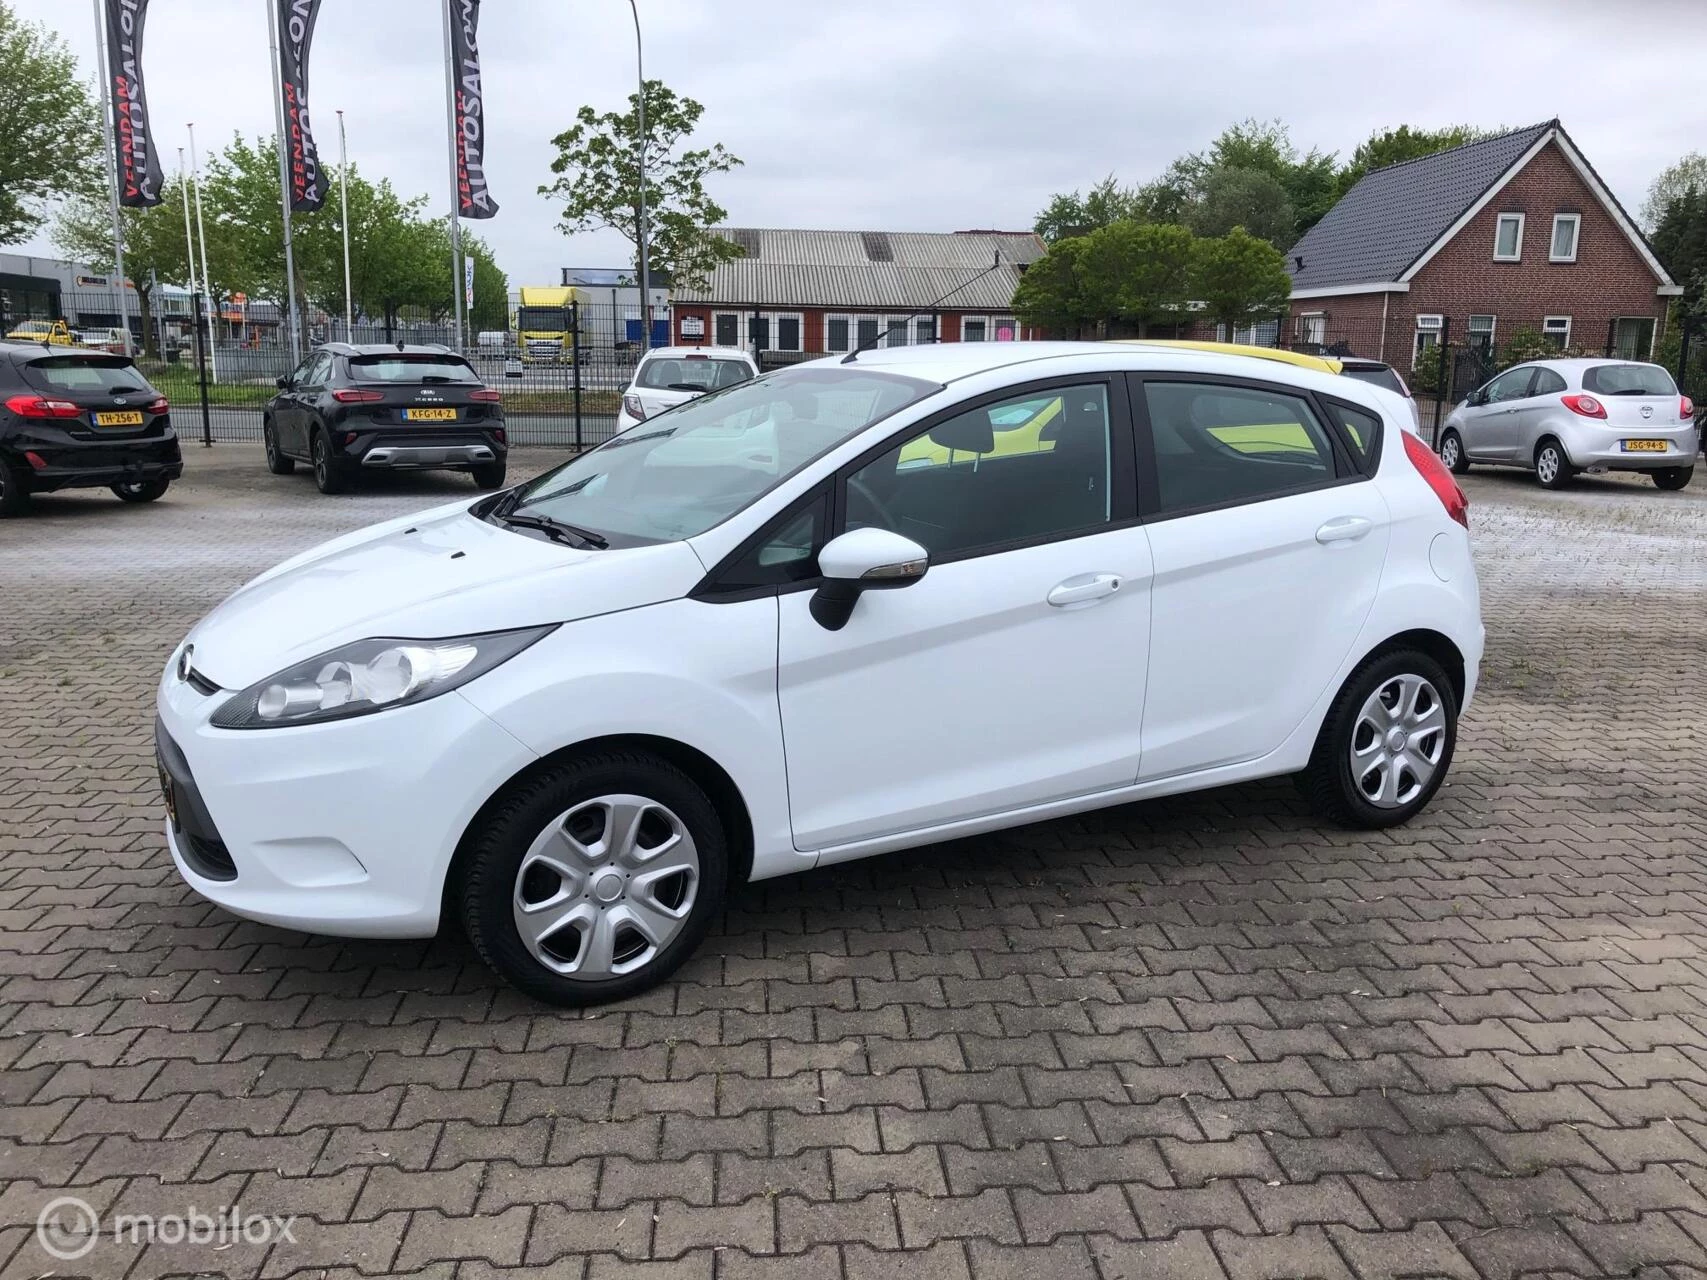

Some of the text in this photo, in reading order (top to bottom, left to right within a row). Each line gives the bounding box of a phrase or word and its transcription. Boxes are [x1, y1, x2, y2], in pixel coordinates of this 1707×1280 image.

[116, 75, 139, 198] VEENDAM
[284, 82, 306, 202] VEENDAM
[99, 413, 139, 424] TH-256-T
[411, 409, 452, 419] KFG-14-Z
[1628, 441, 1664, 450] JSG-94-S
